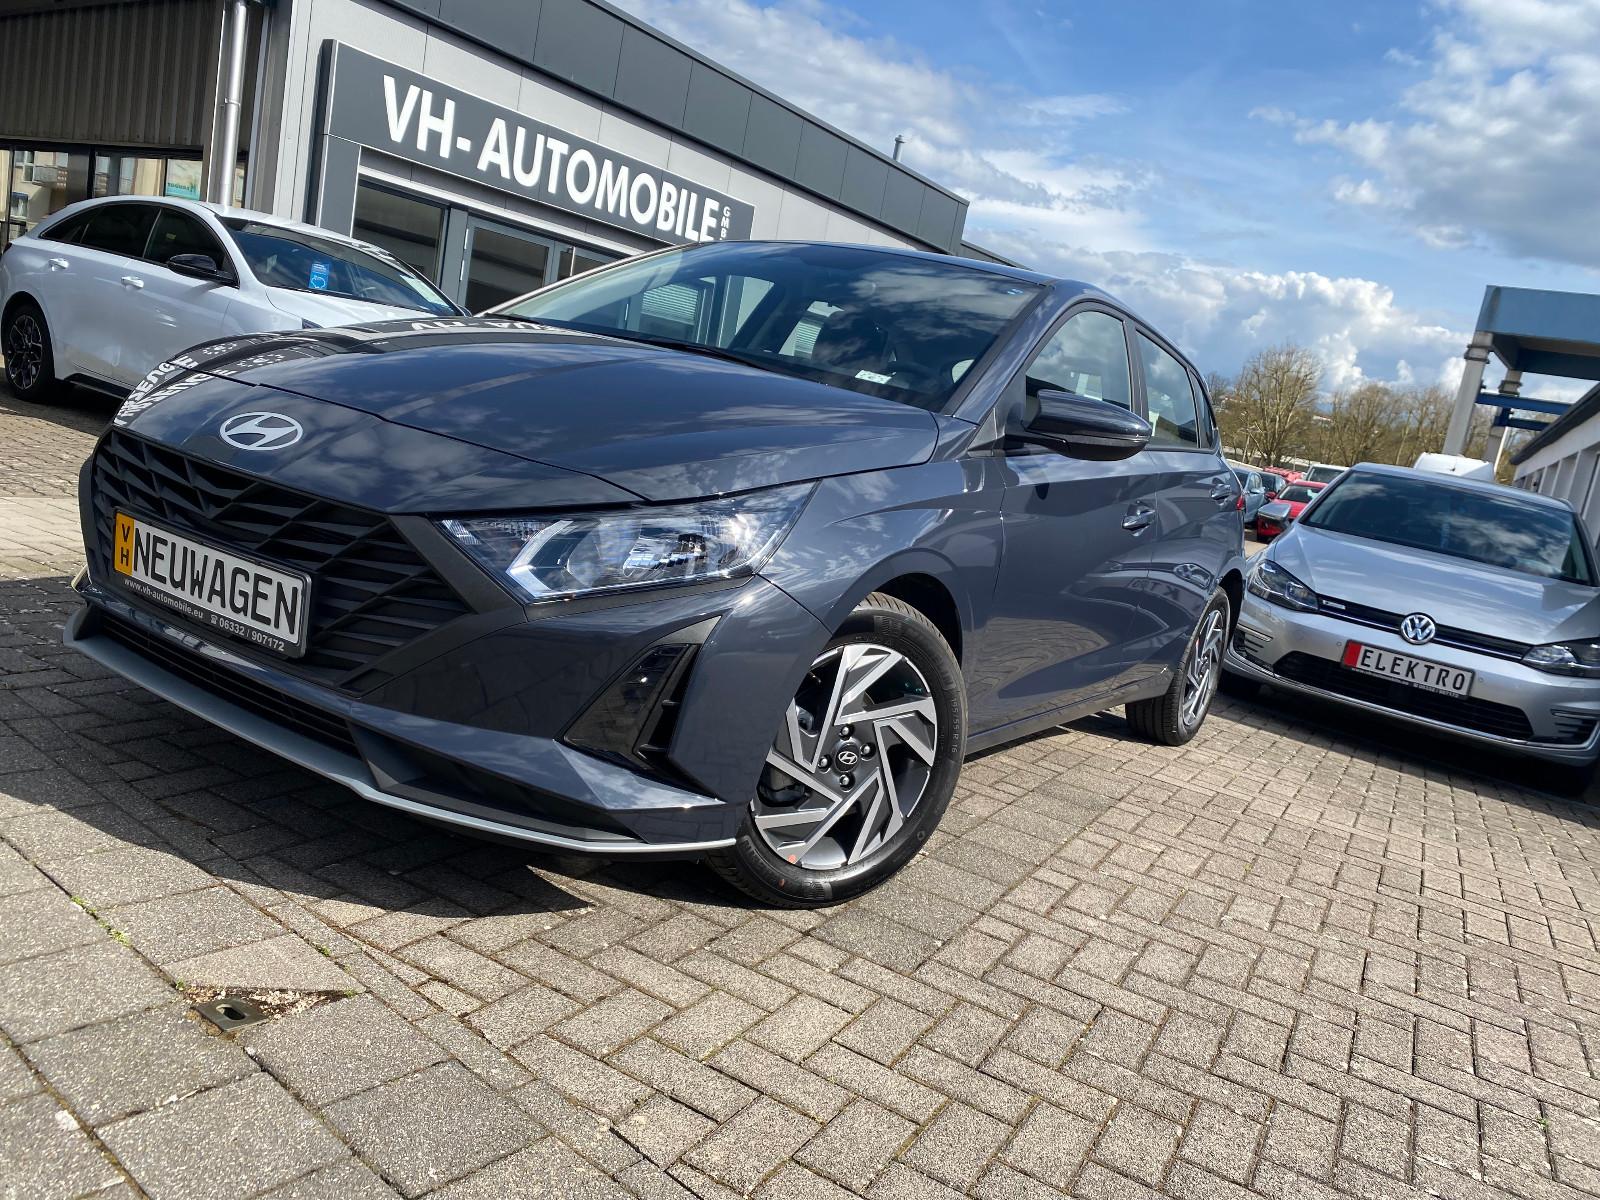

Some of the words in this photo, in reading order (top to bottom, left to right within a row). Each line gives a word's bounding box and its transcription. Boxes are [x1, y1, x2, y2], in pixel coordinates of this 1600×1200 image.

[719, 206, 731, 240] GMB
[133, 528, 299, 635] NEUWAGEN
[123, 578, 204, 619] www.vh-automobile.eu
[219, 619, 245, 636] 06332
[251, 630, 285, 651] 907172
[1360, 649, 1466, 691] ELEKTRO
